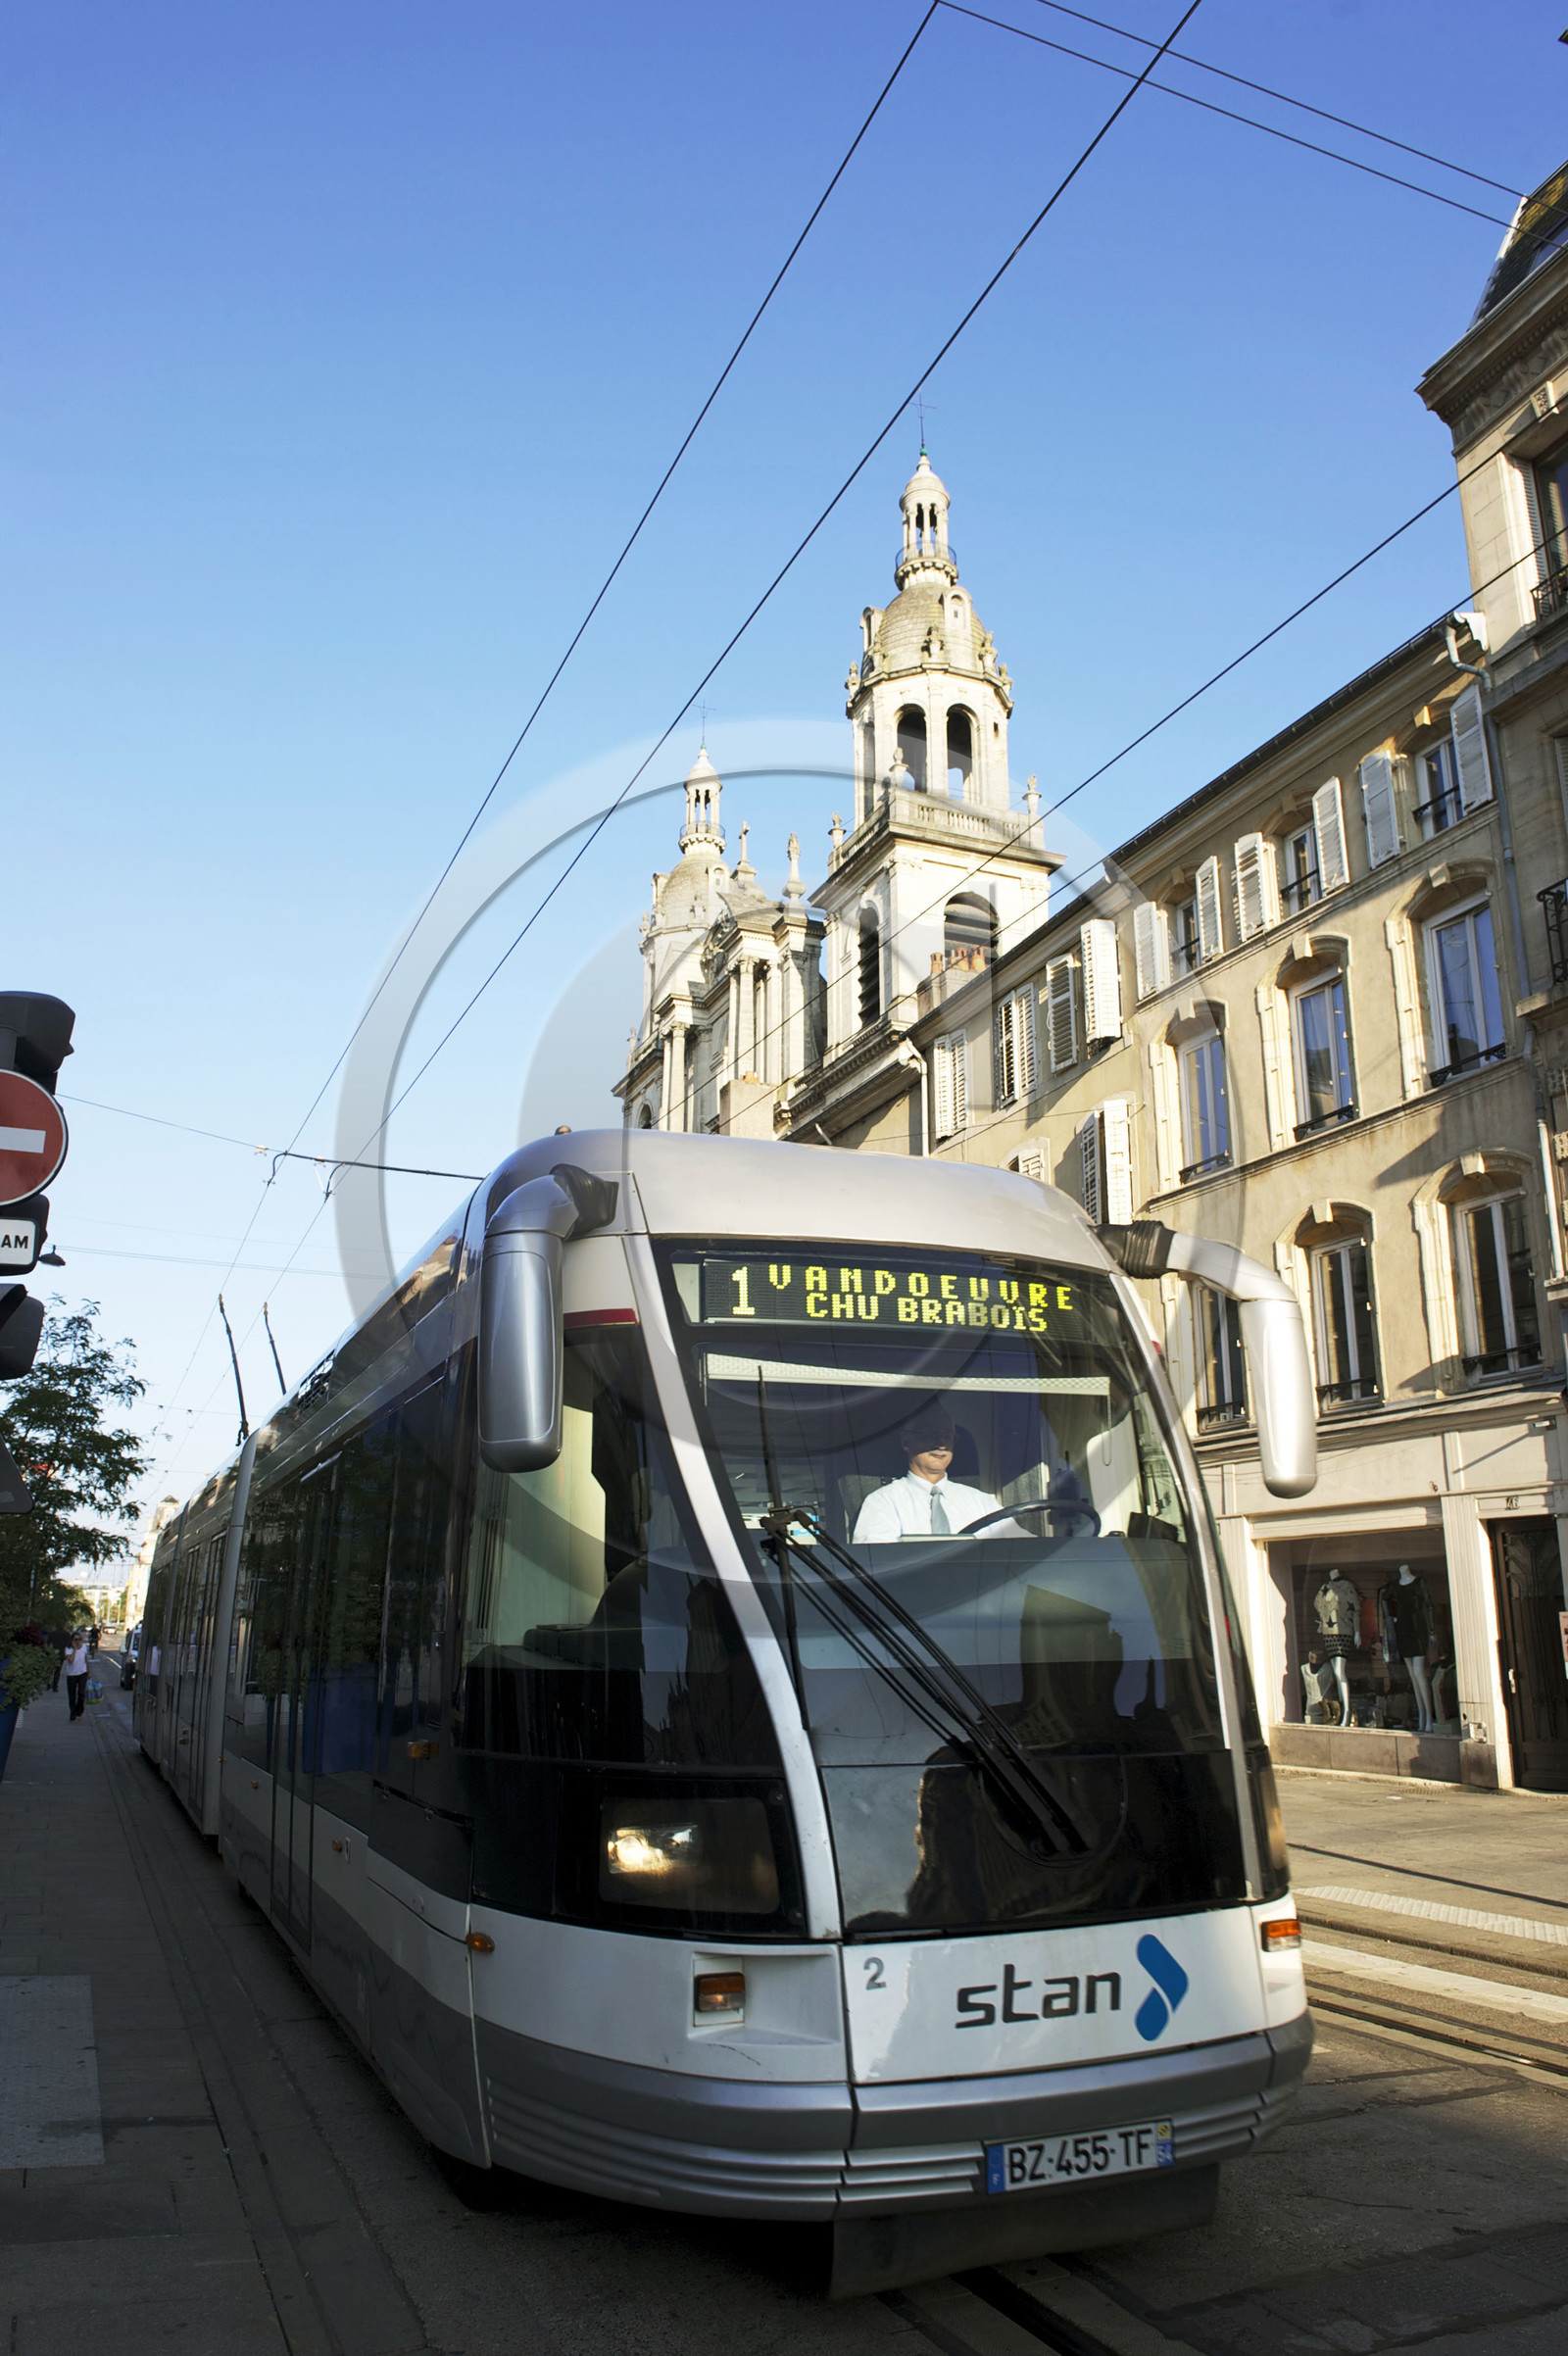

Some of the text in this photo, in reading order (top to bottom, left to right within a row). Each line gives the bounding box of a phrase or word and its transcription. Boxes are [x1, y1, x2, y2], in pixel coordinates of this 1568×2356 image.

[732, 1266, 756, 1315] 1
[768, 1264, 1073, 1310] VANDOEUVRE
[807, 1293, 879, 1320] CHU
[863, 1956, 887, 1990] 2
[955, 1963, 1121, 2029] stan
